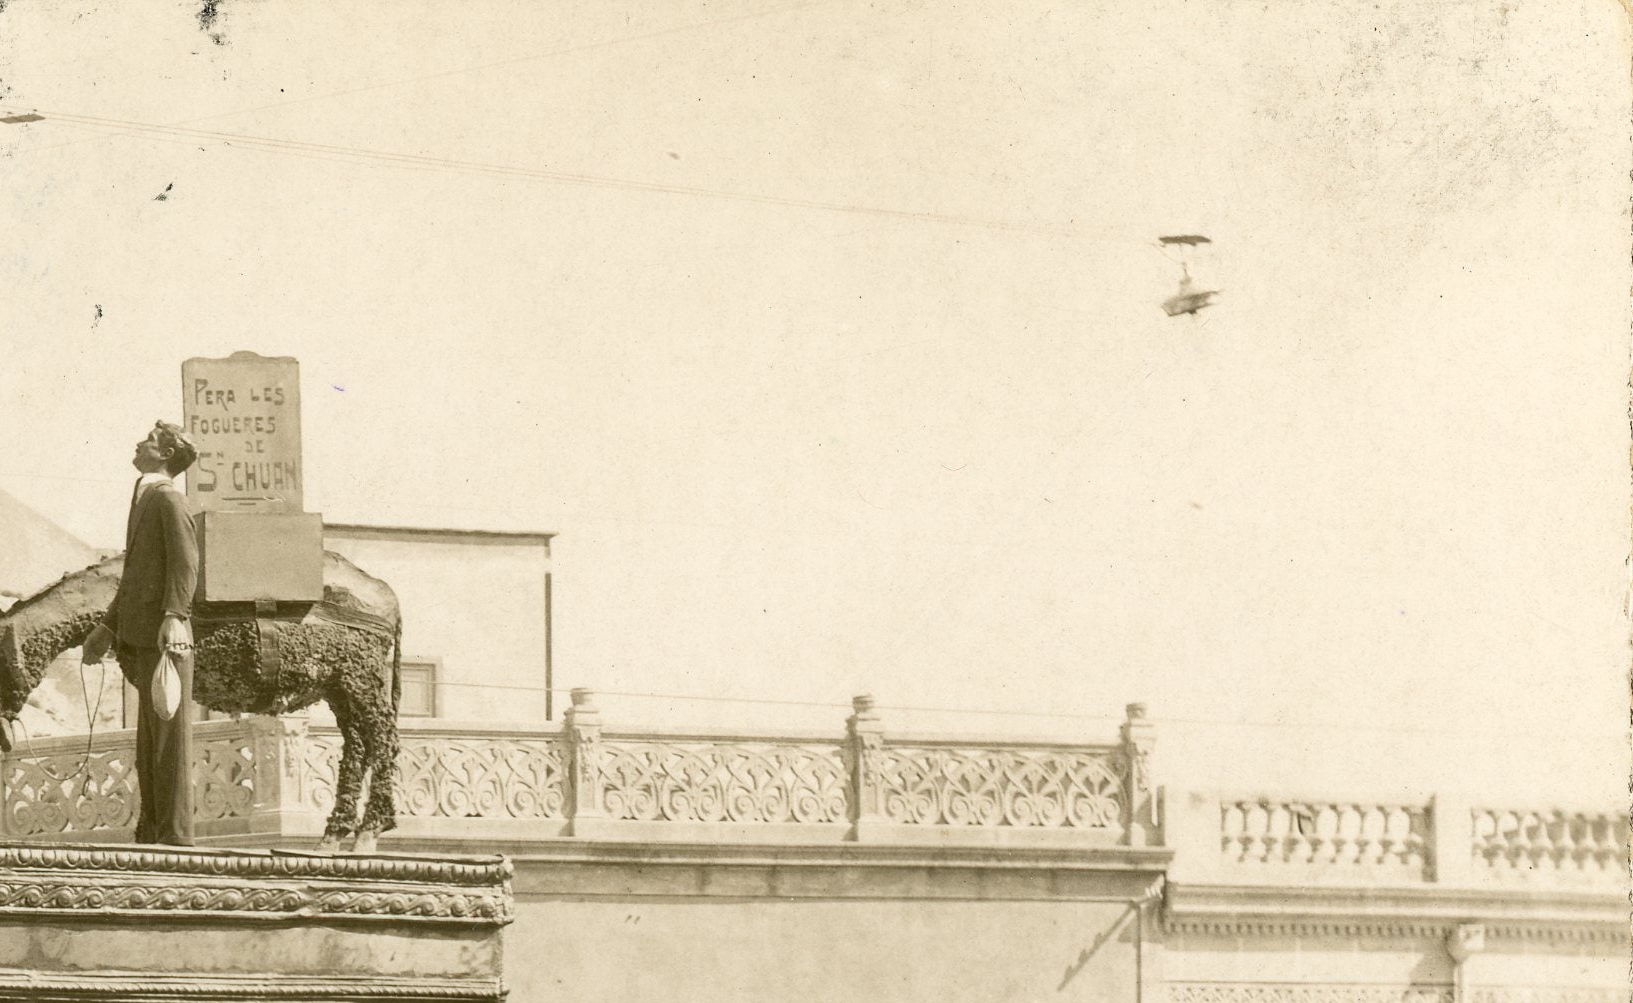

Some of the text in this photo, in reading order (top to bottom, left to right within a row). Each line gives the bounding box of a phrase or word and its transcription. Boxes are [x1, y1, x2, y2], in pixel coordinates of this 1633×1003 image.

[250, 387, 285, 406] LES
[190, 415, 276, 435] FOGUERES
[245, 440, 265, 453] DE
[232, 460, 297, 492] CHUAN
